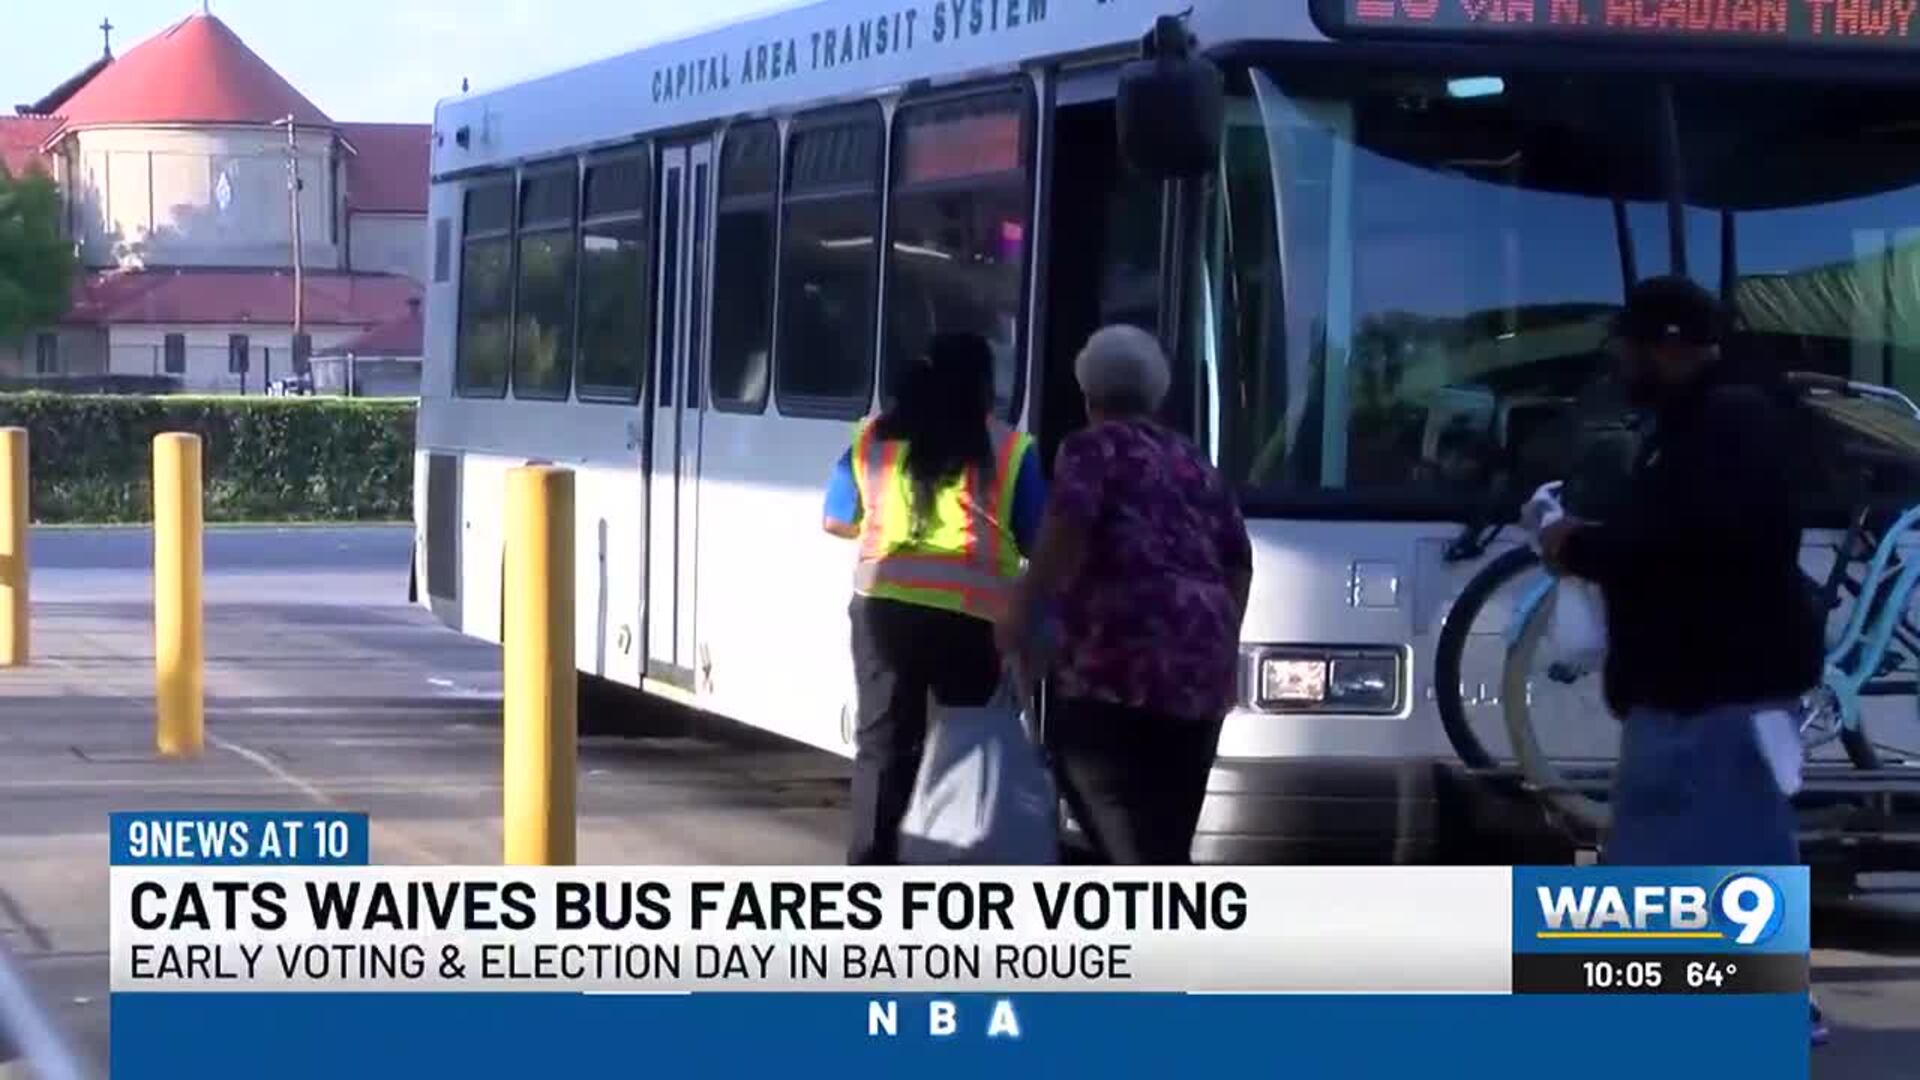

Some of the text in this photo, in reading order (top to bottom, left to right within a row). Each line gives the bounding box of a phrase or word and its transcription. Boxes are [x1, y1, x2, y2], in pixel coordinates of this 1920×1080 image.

[651, 0, 1048, 102] CAPITAL AREA TRANSIT SYSTEM
